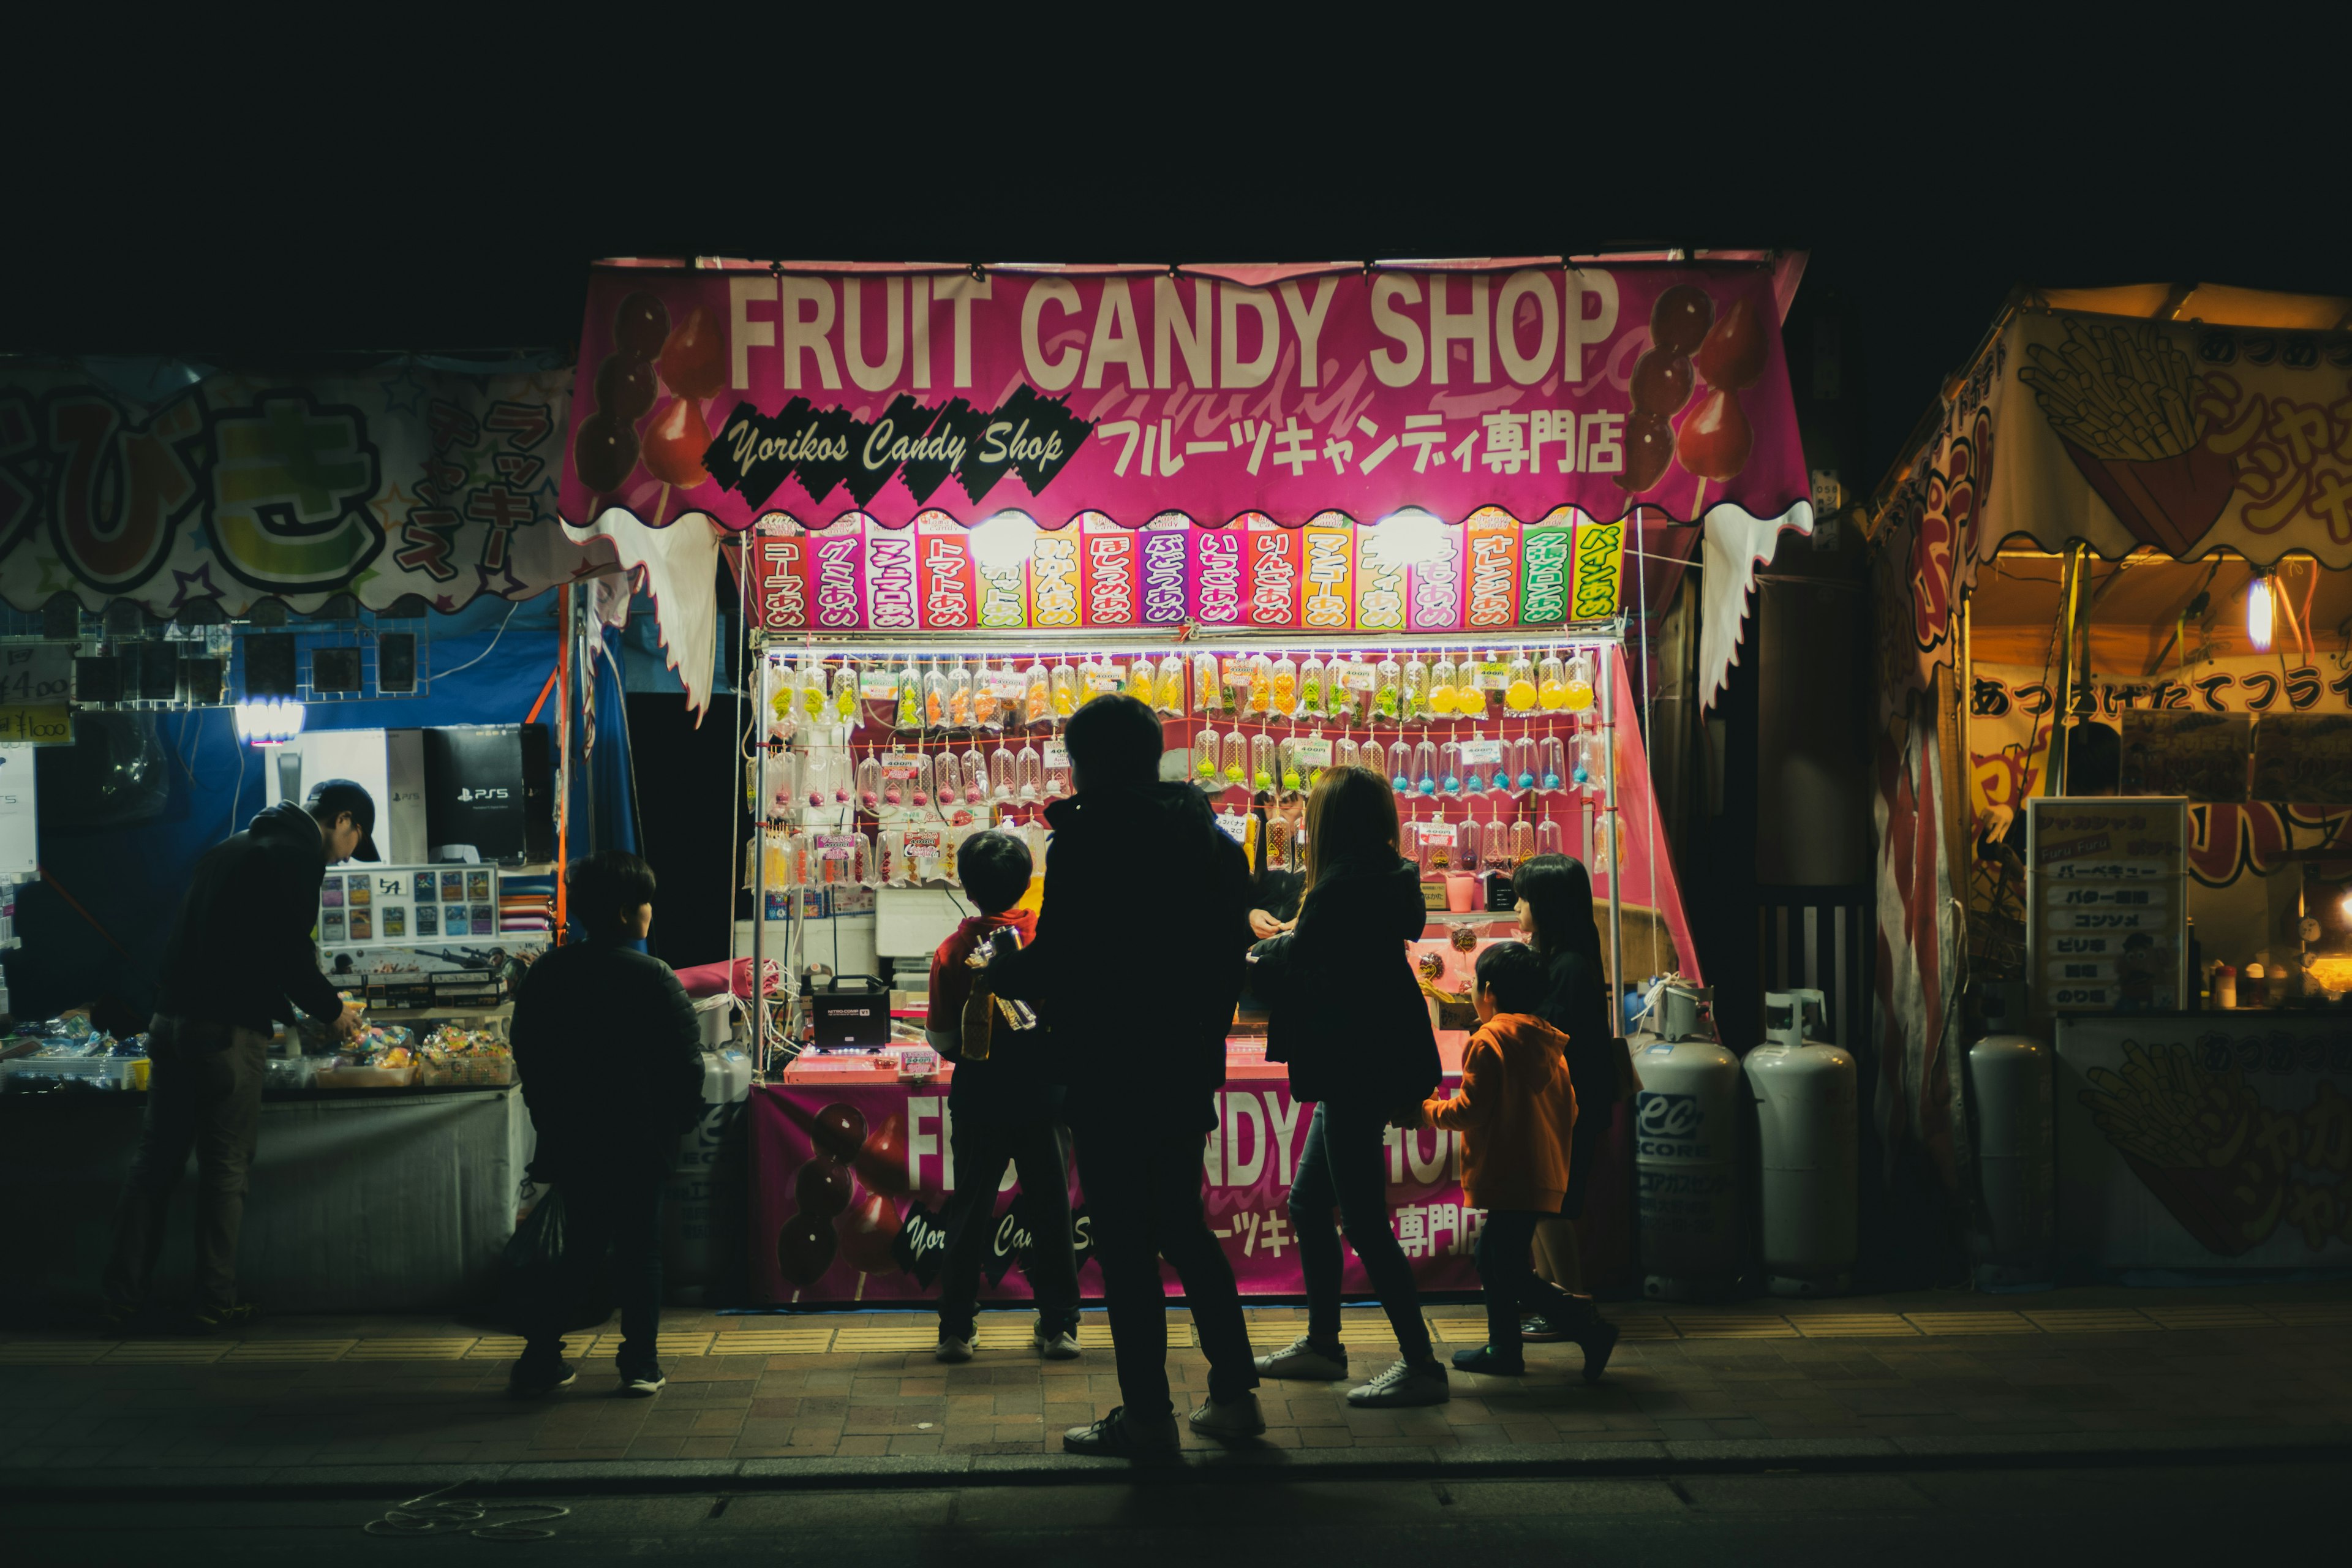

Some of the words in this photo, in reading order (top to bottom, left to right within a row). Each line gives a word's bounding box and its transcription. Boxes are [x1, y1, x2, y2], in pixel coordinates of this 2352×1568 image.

[729, 274, 992, 391] FRUIT
[1020, 276, 1341, 391] CANDY
[1370, 269, 1619, 388] SHOP
[726, 419, 850, 477] Yorikos
[862, 418, 967, 472] Candy
[978, 419, 1064, 472] Shop
[1097, 409, 1627, 477] フルーツキャンディ専門店
[765, 543, 805, 627] コーラあめ
[818, 538, 859, 628] グミあめ
[870, 538, 914, 628] マシュマロあめ
[925, 538, 969, 627] トマトあめ
[1035, 538, 1077, 625] みかんあめ
[1145, 533, 1186, 622] ぶどうあめ
[1199, 533, 1239, 622] いちごあめ
[1252, 533, 1295, 624] りんごあめ
[1306, 533, 1349, 627] マンゴーあめ
[1471, 535, 1513, 626] オレンジあめ
[1524, 532, 1568, 622] 夕張メロンあめ
[1577, 526, 1621, 617] パインあめ
[475, 788, 509, 799] PS5
[2041, 848, 2071, 861] Furu
[2077, 838, 2108, 853] Furu
[2058, 864, 2157, 878] バーベキュー
[2075, 914, 2139, 927] コンソメ
